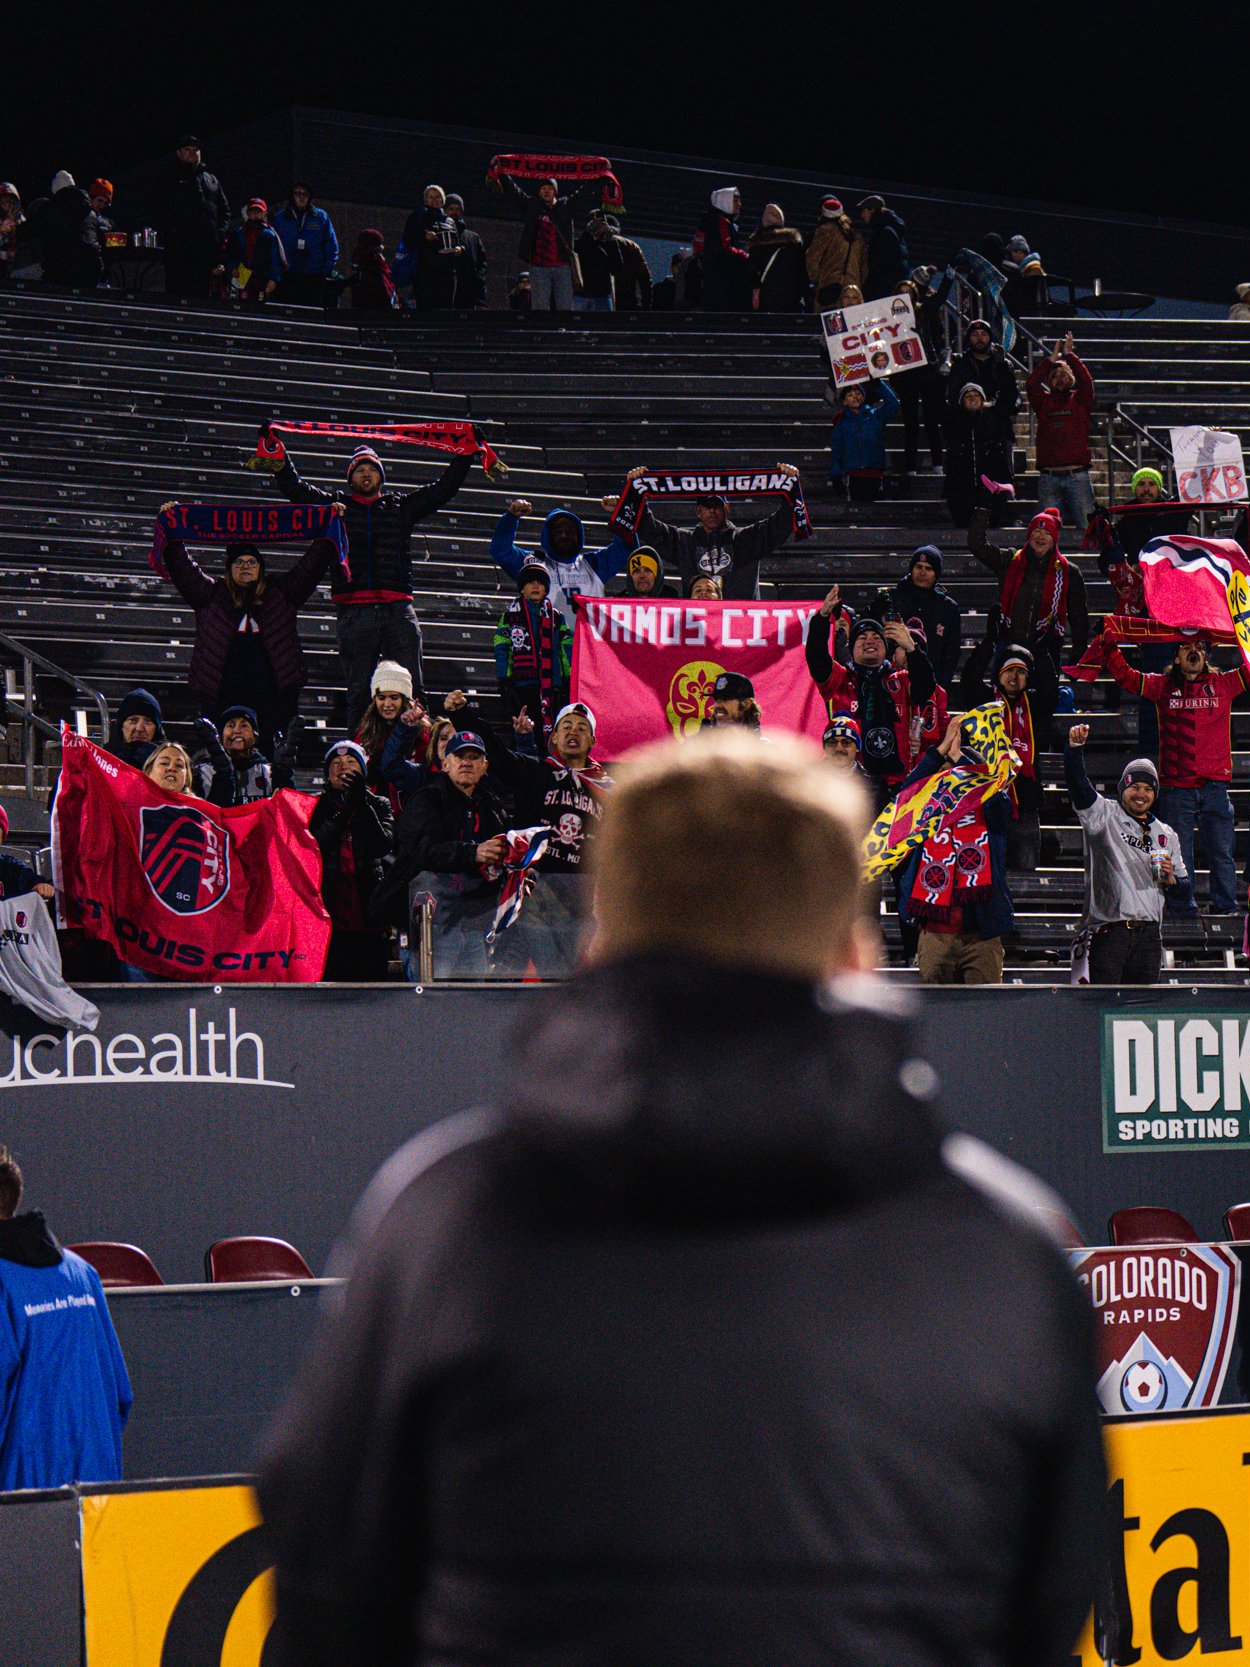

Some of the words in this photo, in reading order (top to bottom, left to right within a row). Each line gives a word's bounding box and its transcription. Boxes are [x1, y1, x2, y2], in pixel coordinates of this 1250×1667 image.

[526, 161, 577, 172] LOUIS
[842, 322, 901, 350] CITY
[1179, 466, 1245, 502] CKB
[213, 509, 279, 532] LOUIS
[586, 603, 707, 647] VAMOS
[201, 830, 219, 895] CITY
[175, 891, 191, 902] SC
[213, 948, 296, 971] CITY
[1118, 1117, 1239, 1141] SPORTING
[1103, 1307, 1181, 1325] RAPIDS
